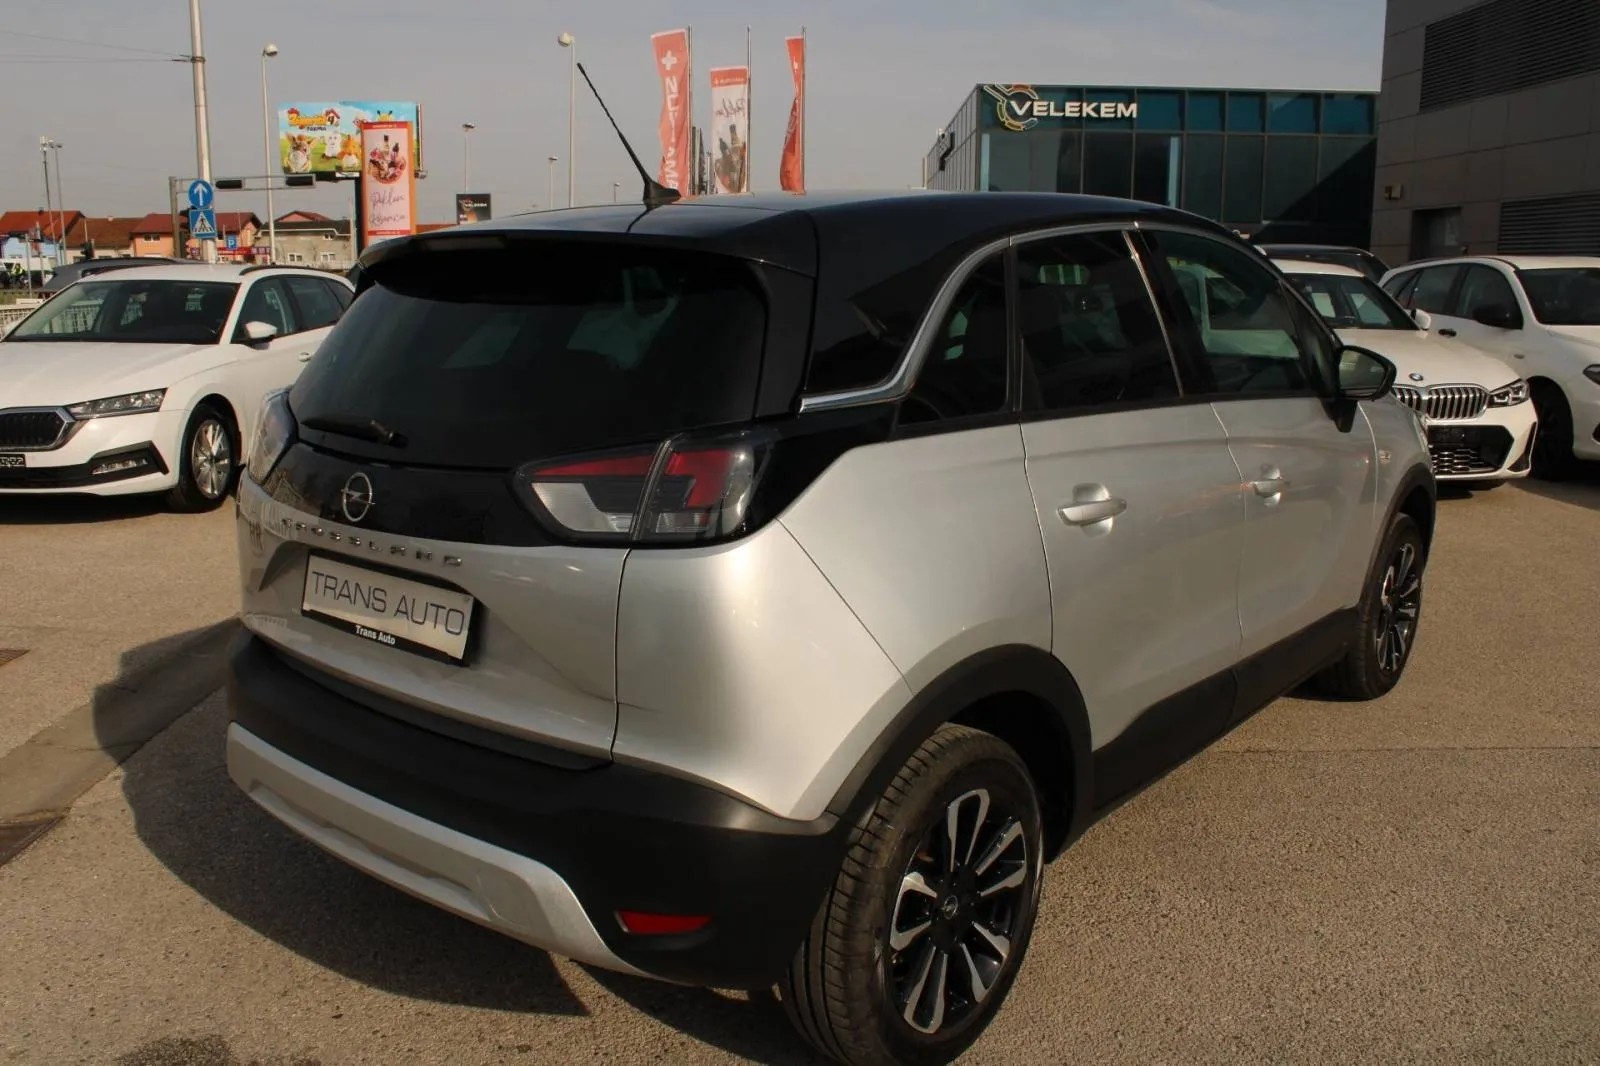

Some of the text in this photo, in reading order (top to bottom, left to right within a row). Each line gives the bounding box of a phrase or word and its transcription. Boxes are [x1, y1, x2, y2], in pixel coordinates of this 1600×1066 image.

[1009, 100, 1138, 118] VELEKEM
[228, 239, 235, 247] P
[311, 571, 466, 636] TRANS AUTO
[355, 624, 396, 646] Trans Auto
